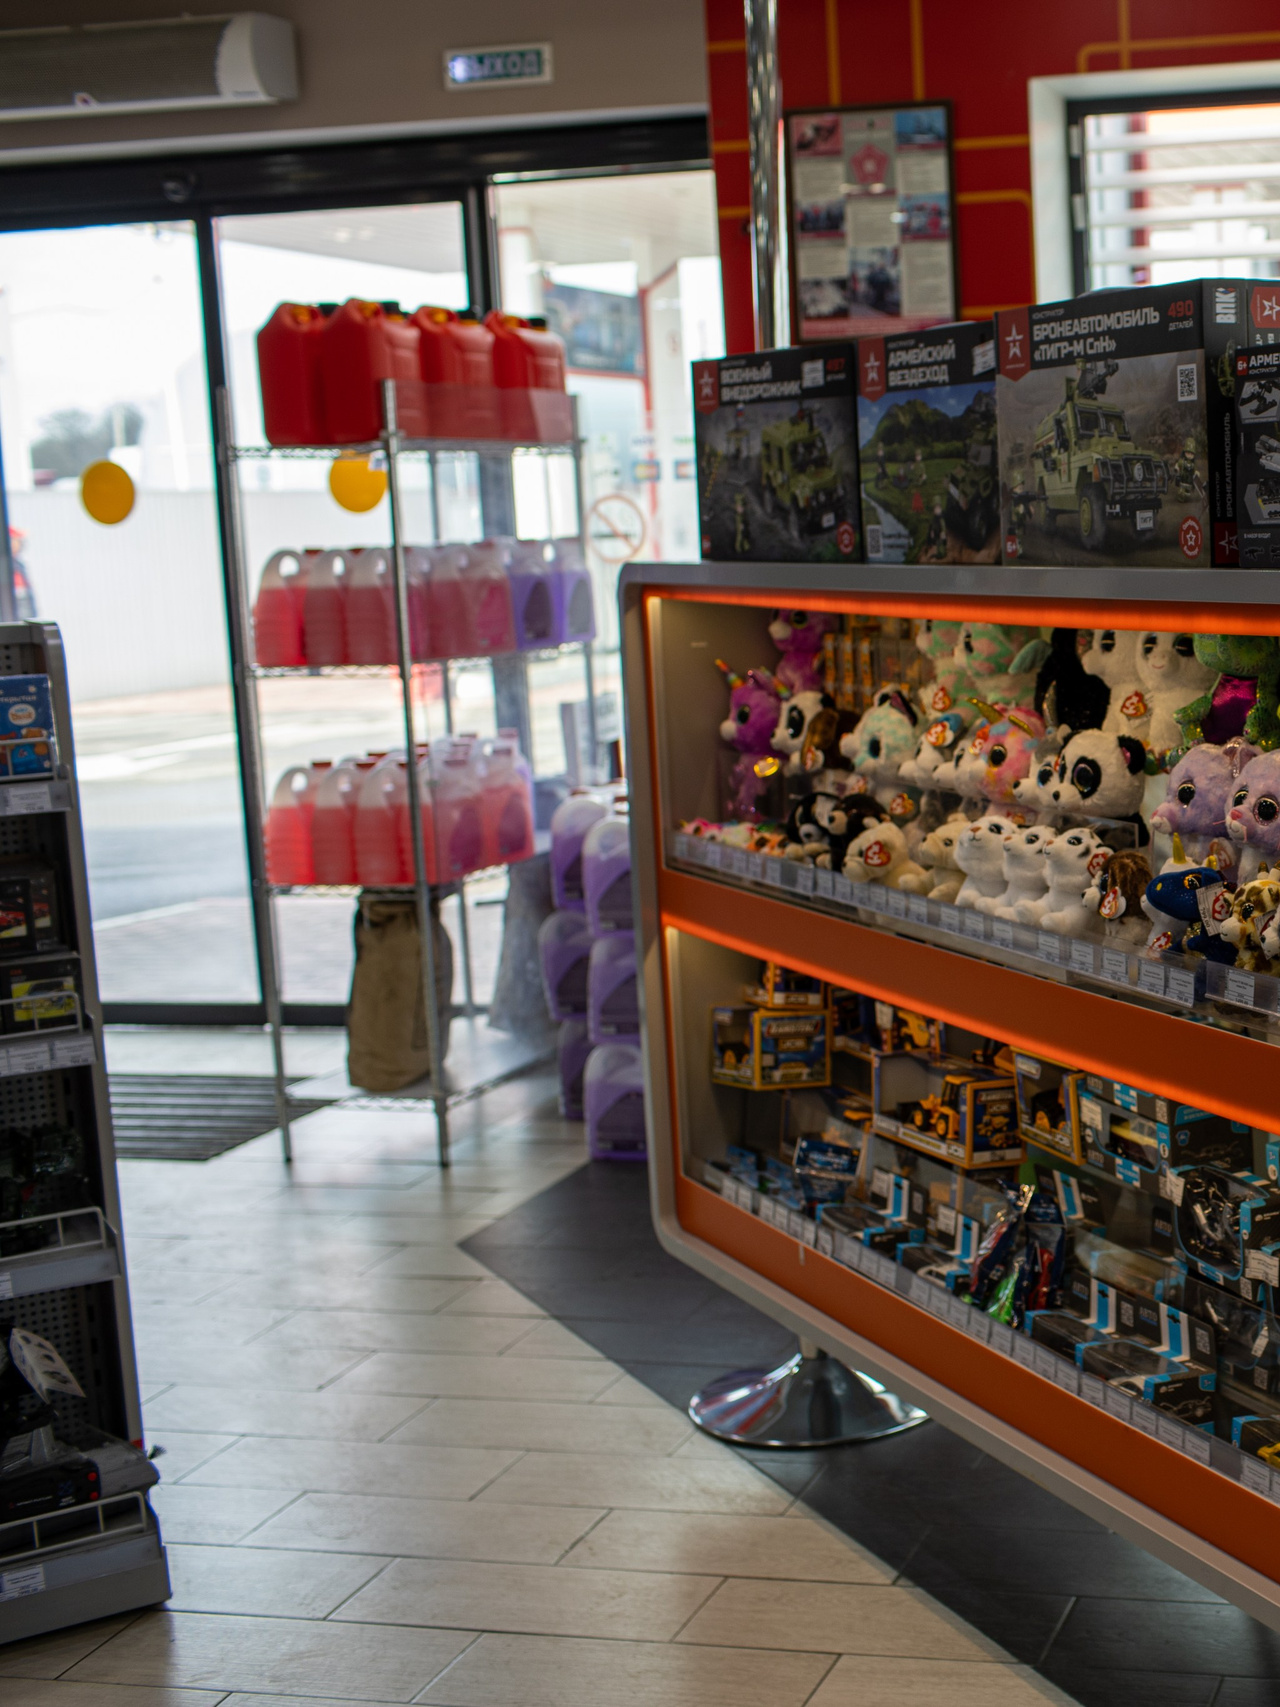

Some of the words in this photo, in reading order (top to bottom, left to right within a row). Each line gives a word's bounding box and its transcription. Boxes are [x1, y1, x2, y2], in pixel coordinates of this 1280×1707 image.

[1167, 300, 1194, 318] 490
[1215, 291, 1237, 323] ВПК
[1032, 306, 1160, 341] БРОНЕАВТОМОБИЛЬ
[1168, 319, 1194, 331] ДЕТАЛЕЙ
[888, 339, 956, 367] АРМЕЙСКИЙ
[1033, 339, 1086, 361] «ТИГР-М
[1086, 335, 1117, 354] СпН»
[888, 364, 949, 387] ВЕЗДЕХОД
[1237, 360, 1247, 370] 6+
[1226, 412, 1234, 518] БРОНЕАВТОМОБИЛЬ
